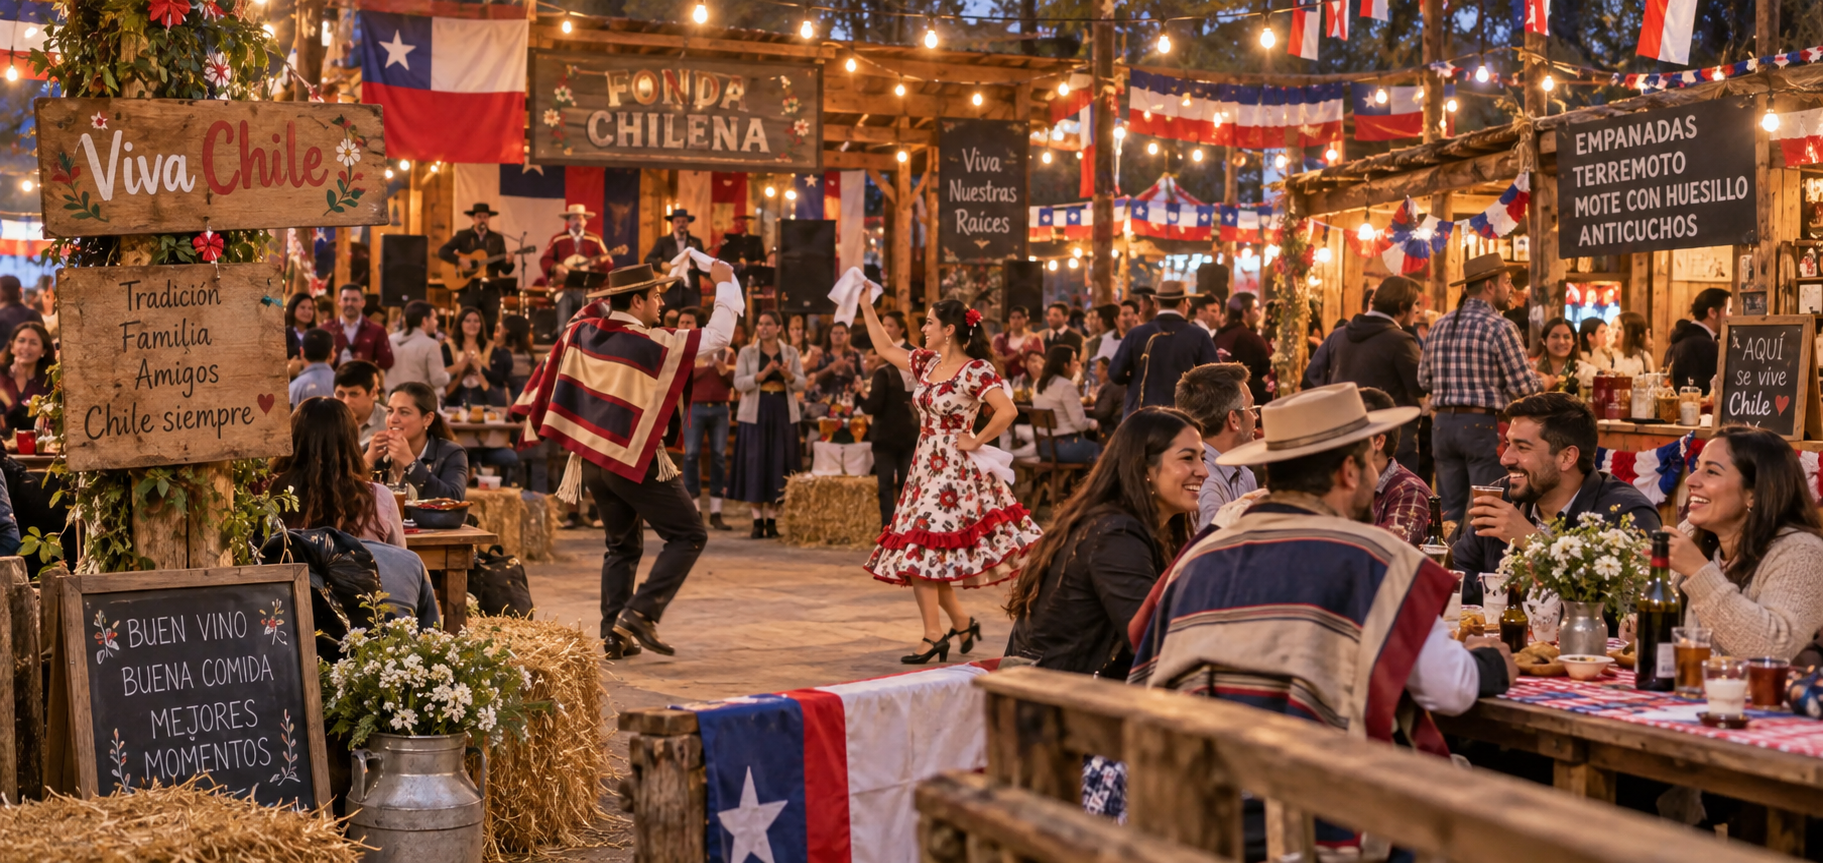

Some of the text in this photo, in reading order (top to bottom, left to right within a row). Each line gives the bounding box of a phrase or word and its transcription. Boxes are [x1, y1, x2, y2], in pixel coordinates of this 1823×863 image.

[605, 68, 748, 112] FONDA
[586, 111, 770, 153] CHILENA
[1576, 114, 1697, 155] EMPANADAS
[79, 120, 329, 201] Viva Chile
[962, 146, 1002, 173] Viva
[1572, 152, 1685, 188] TERREMOTO
[949, 179, 1017, 203] Nuestras
[1574, 175, 1748, 218] MOTE CON HUESILLO
[955, 208, 1010, 235] Raíces
[1579, 213, 1698, 246] ANTICUCHOS
[119, 279, 221, 312] Tradición
[119, 318, 212, 352] Familia
[1743, 332, 1786, 364] AQUÍ
[135, 359, 219, 397] Amigos
[1735, 367, 1786, 386] se vive
[84, 397, 255, 438] Chile siempre
[1729, 391, 1771, 416] Chile
[127, 610, 247, 648] BUEN VINO
[122, 654, 274, 696] BUENA COMIDA
[151, 698, 258, 739] MEJORES
[145, 736, 271, 780] MOMENTOS
